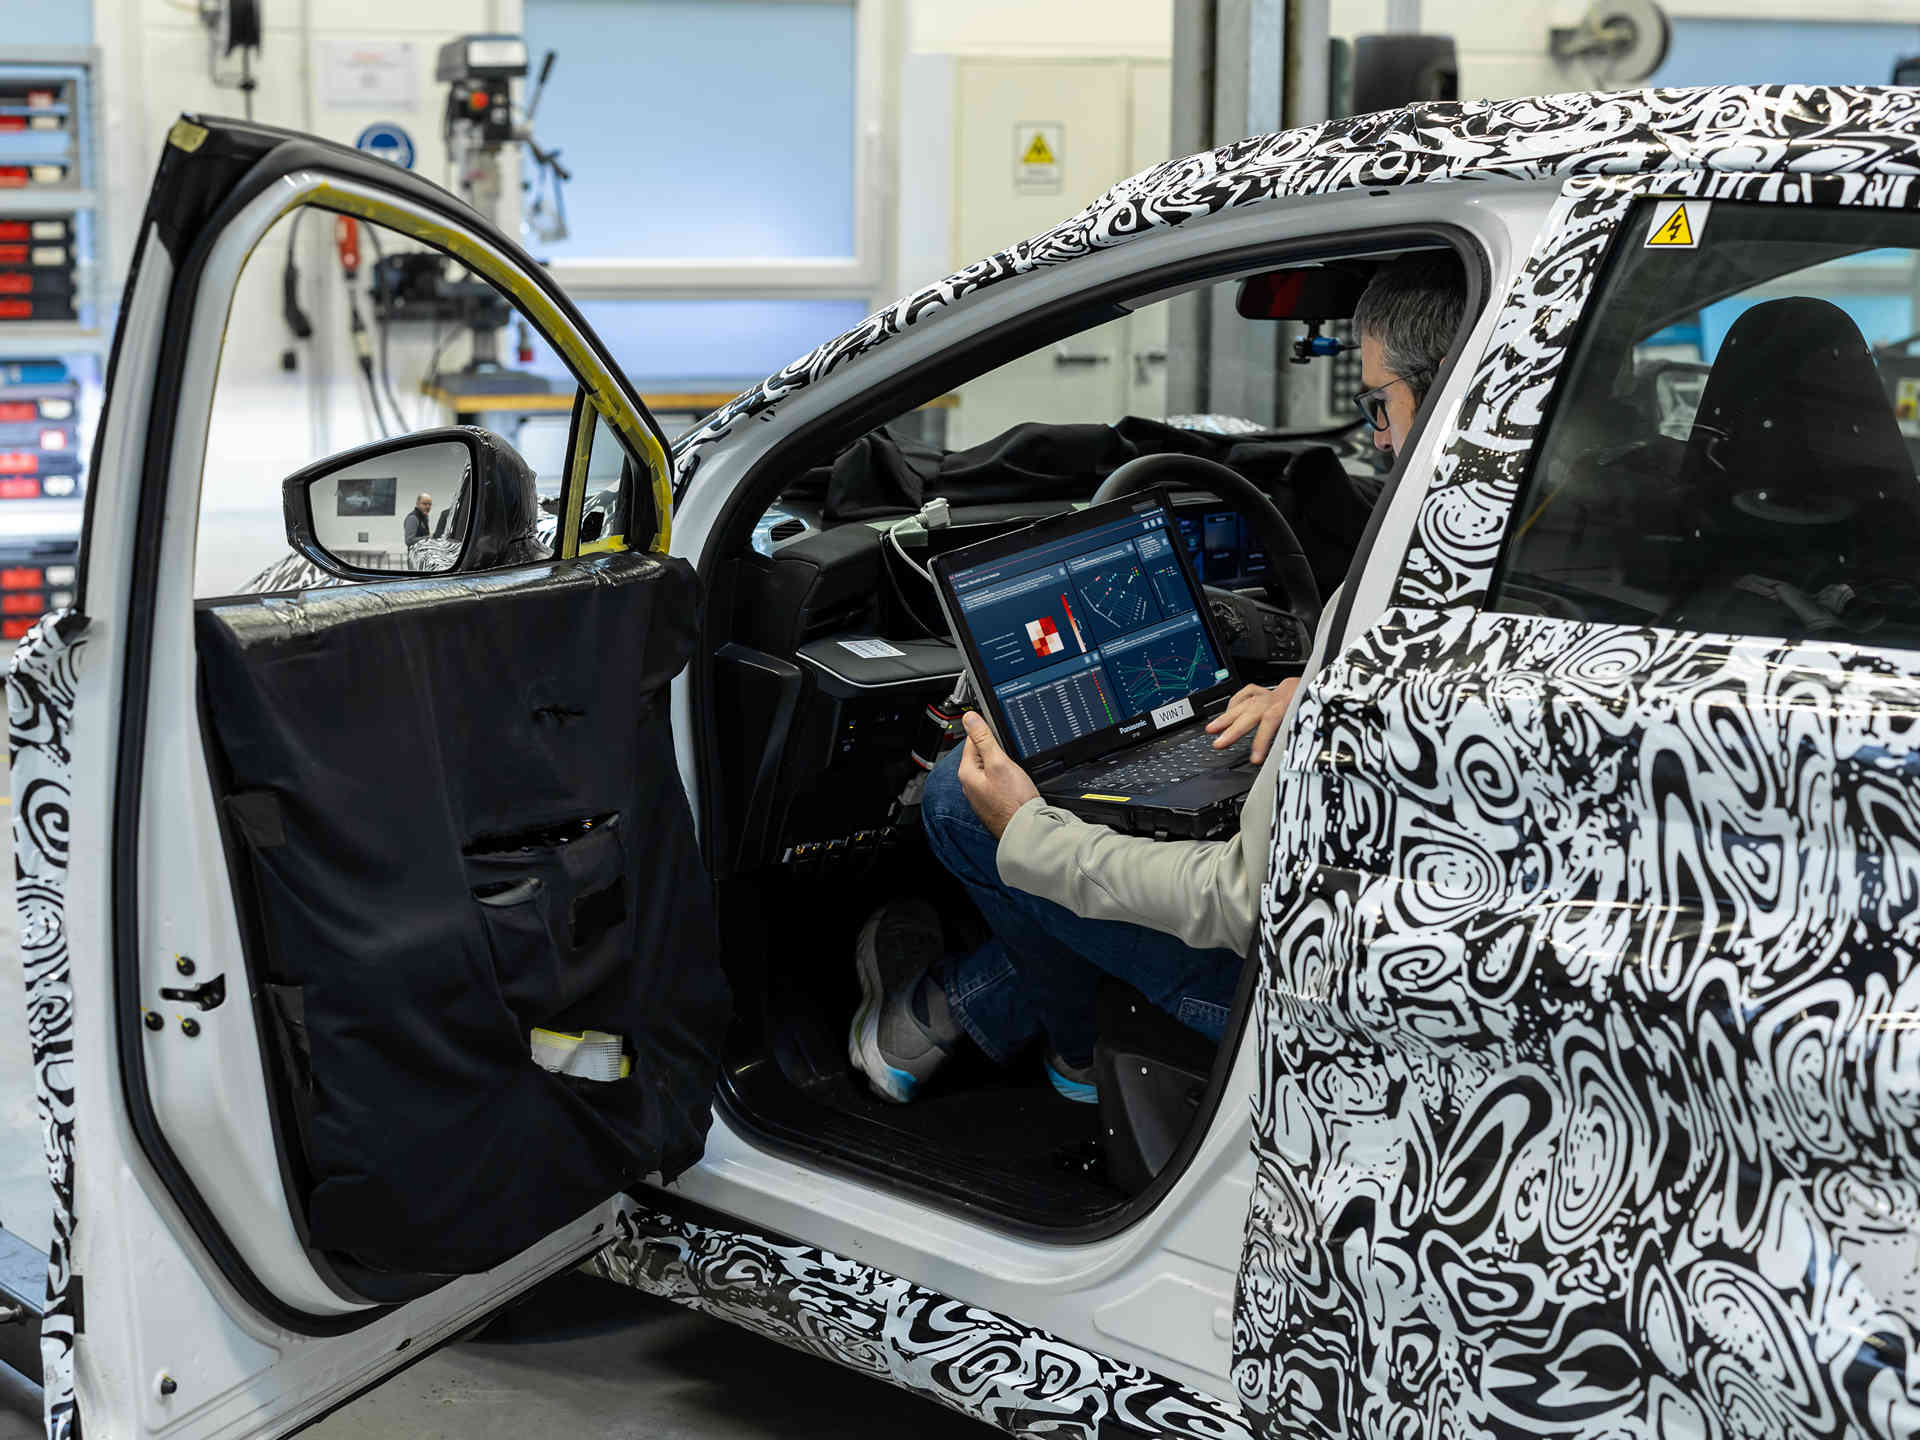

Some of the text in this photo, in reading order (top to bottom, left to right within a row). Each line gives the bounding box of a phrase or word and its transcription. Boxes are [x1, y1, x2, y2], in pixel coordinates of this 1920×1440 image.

[1159, 705, 1184, 722] WIN 7
[1119, 719, 1147, 734] Panasonic
